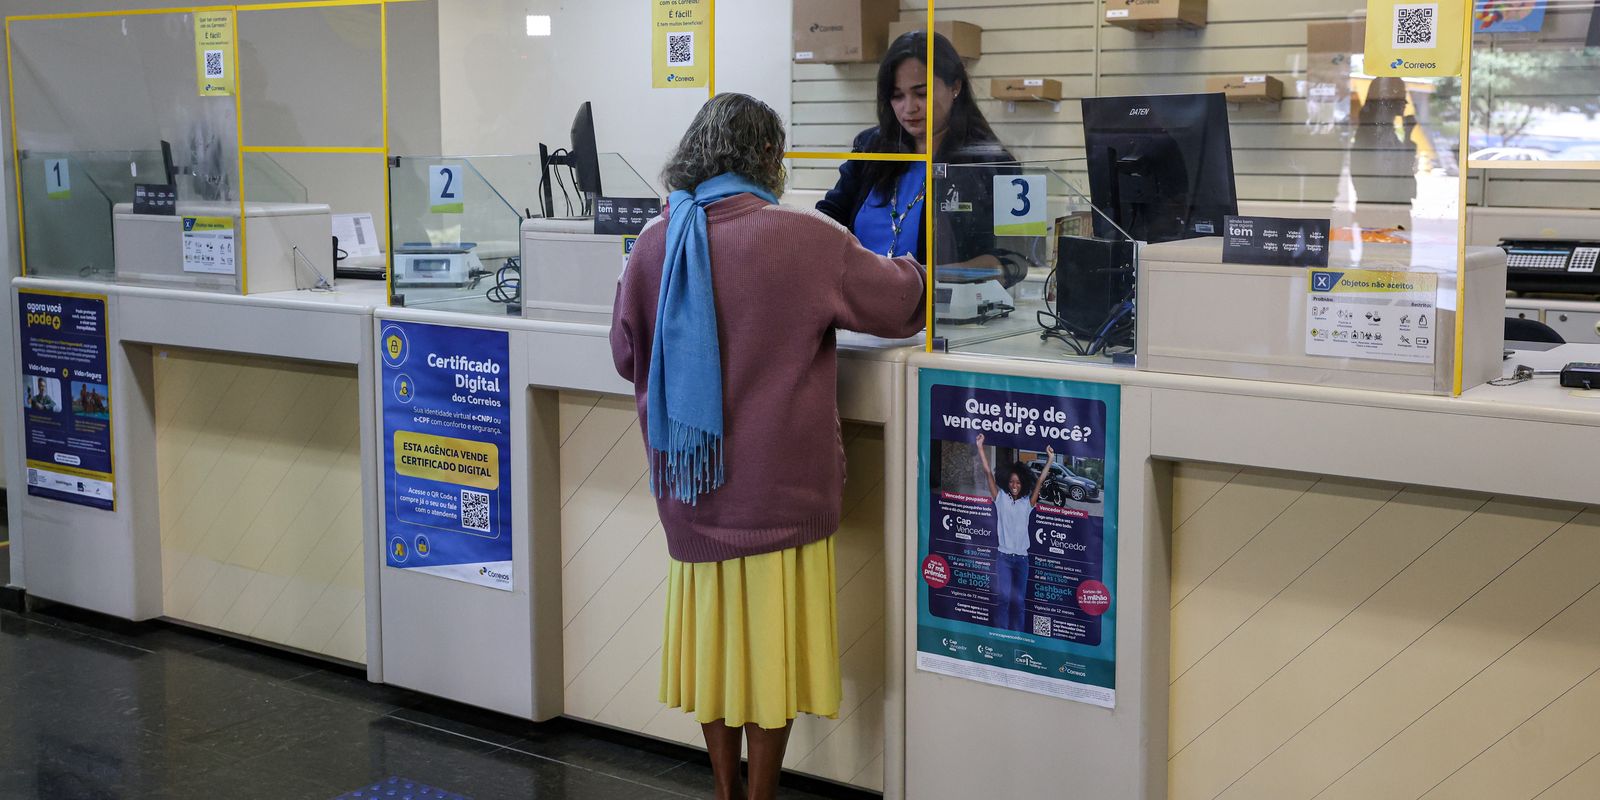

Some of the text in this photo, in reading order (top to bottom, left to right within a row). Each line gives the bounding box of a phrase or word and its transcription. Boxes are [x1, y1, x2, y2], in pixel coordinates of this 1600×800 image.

[669, 10, 673, 18] É
[1403, 61, 1436, 69] Correios
[1129, 108, 1150, 116] DATEN
[53, 161, 62, 187] 1
[440, 167, 455, 198] 2
[1010, 178, 1030, 216] 3
[1229, 227, 1252, 236] tem
[27, 303, 62, 312] agora você
[427, 353, 500, 374] Certificado
[455, 374, 500, 393] Digital
[452, 393, 501, 407] dos Correios
[414, 406, 423, 414] Sua
[424, 407, 452, 417] identidade
[453, 410, 471, 419] virtual
[472, 414, 493, 423] e-CNPJ
[965, 398, 1067, 423] Que tipo de
[443, 419, 466, 429] conforto
[942, 414, 1092, 442] vencedor é você?
[403, 442, 488, 462] ESTA AGÊNCIA VENDE
[401, 455, 491, 477] CERTIFICADO DIGITAL
[408, 487, 425, 496] Acesse
[431, 490, 439, 498] QR
[400, 495, 419, 504] compre
[419, 496, 424, 505] já
[447, 502, 457, 510] fale
[431, 508, 457, 519] atendente
[957, 517, 971, 526] Cap
[957, 524, 991, 536] Vencedor
[1051, 530, 1066, 540] Cap
[1051, 539, 1086, 551] Vencedor
[488, 570, 509, 580] Correios
[925, 569, 947, 579] prêmios
[954, 570, 990, 581] Cashback
[969, 579, 989, 588] 100%
[1035, 583, 1072, 596] Cashback
[1046, 592, 1063, 601] 50%
[1067, 668, 1086, 677] Correios
